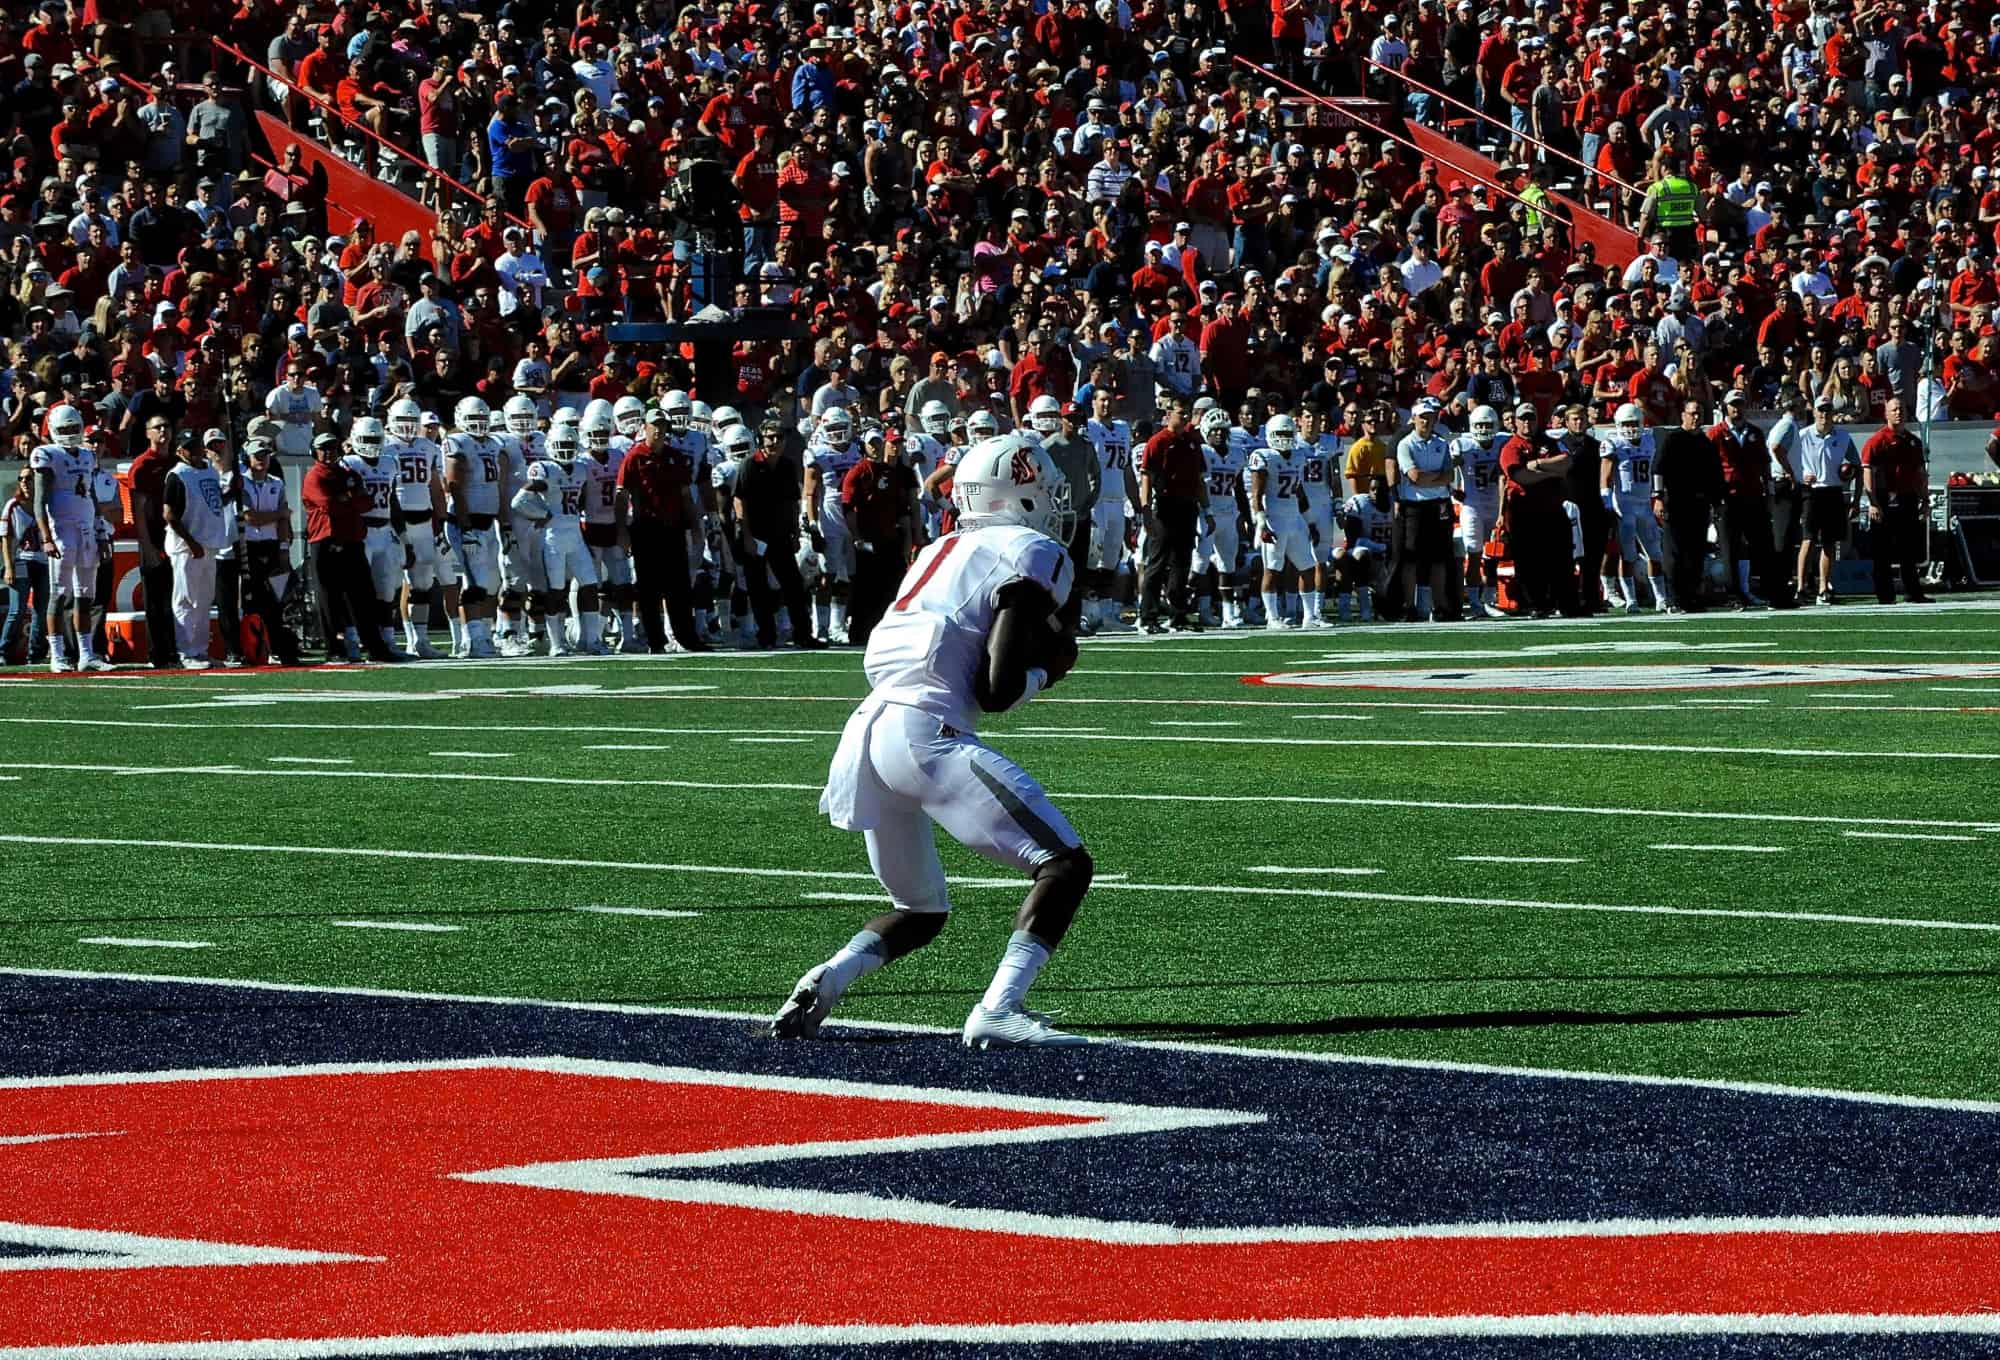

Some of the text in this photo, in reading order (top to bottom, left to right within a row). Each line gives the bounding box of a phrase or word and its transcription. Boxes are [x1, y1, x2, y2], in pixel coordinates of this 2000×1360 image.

[1175, 354, 1190, 372] 12
[1105, 444, 1126, 469] 76
[400, 456, 427, 483] 56
[367, 483, 390, 509] 23
[1210, 471, 1236, 496] 32
